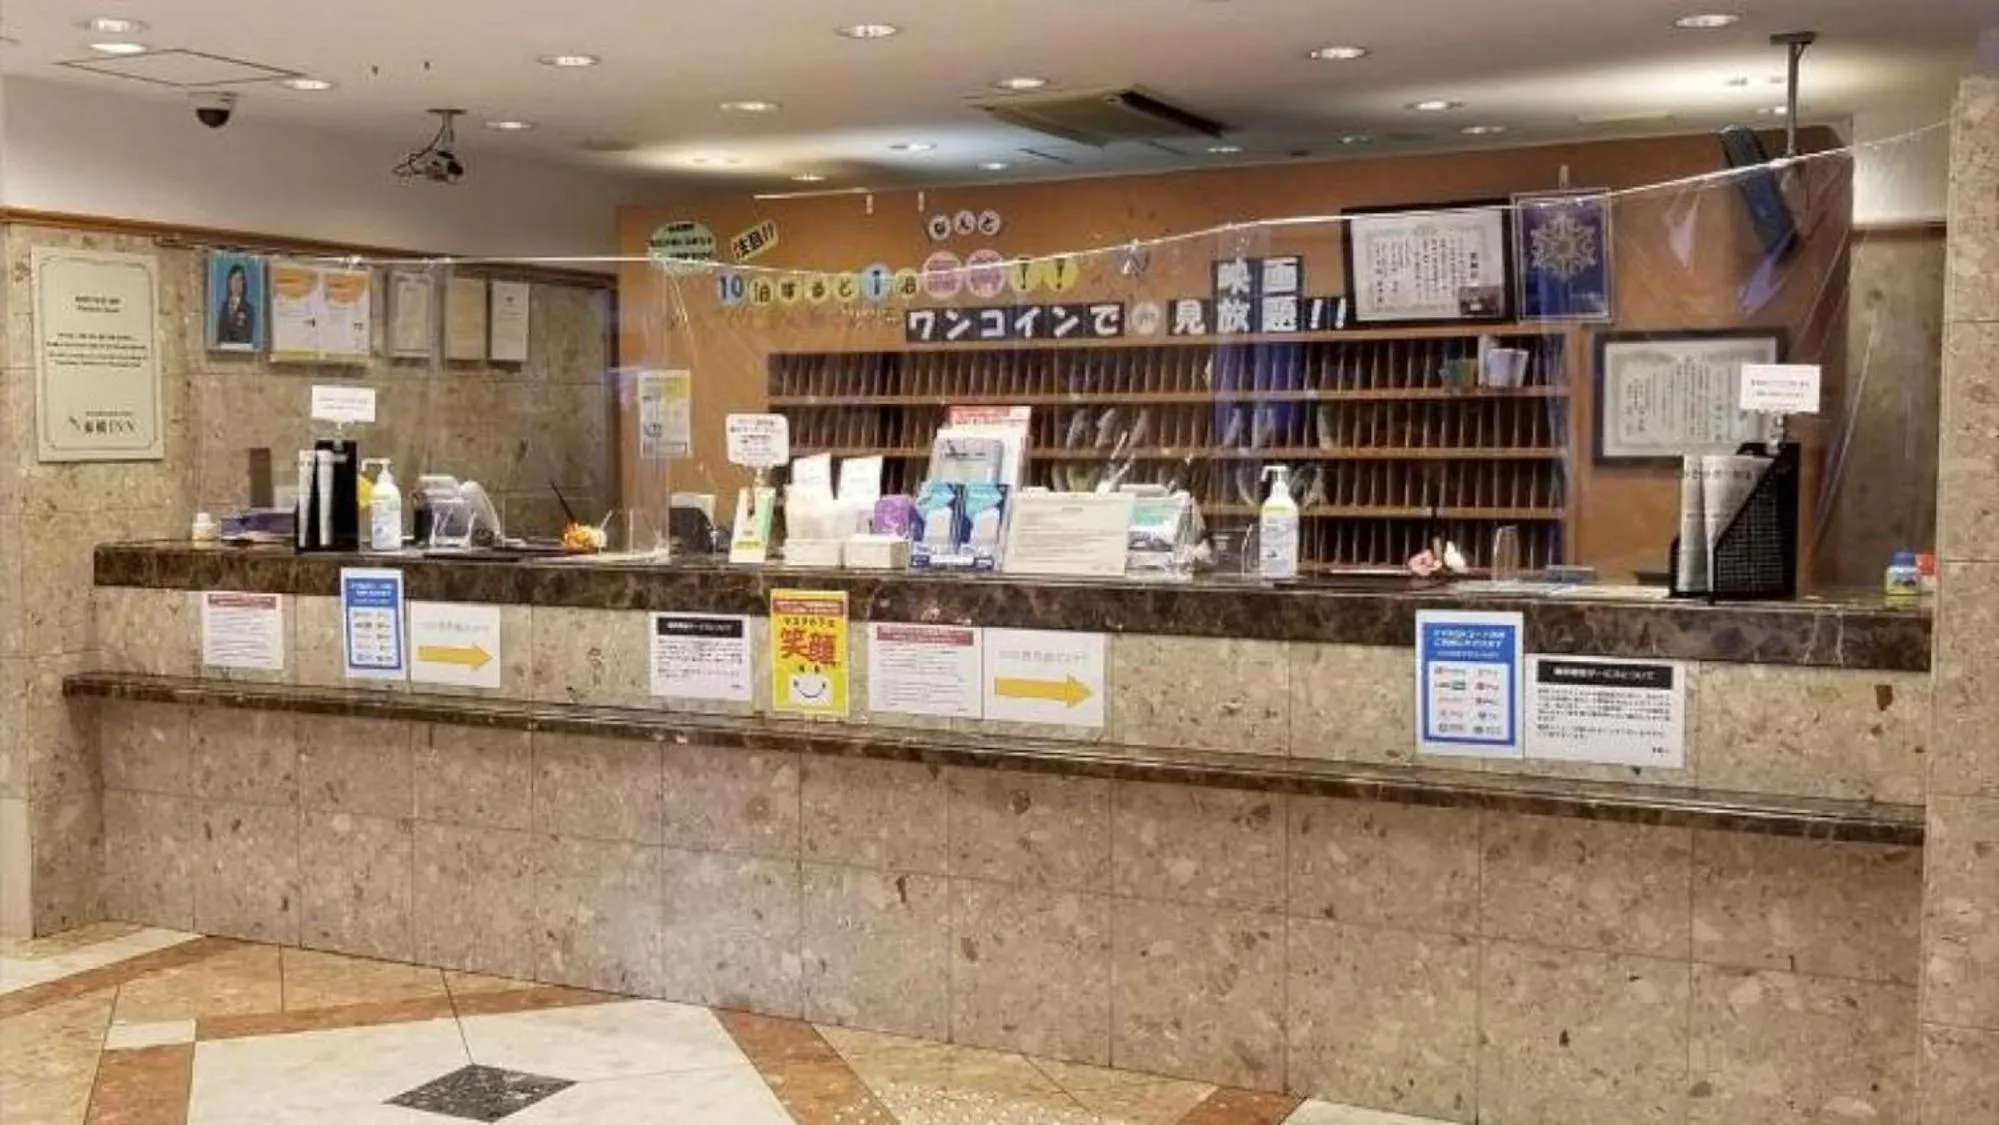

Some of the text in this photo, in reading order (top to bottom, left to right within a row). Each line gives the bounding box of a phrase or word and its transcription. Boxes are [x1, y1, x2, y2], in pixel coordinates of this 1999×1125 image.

[908, 303, 1121, 341] ワンコインで
[780, 627, 837, 664] 笑顔
